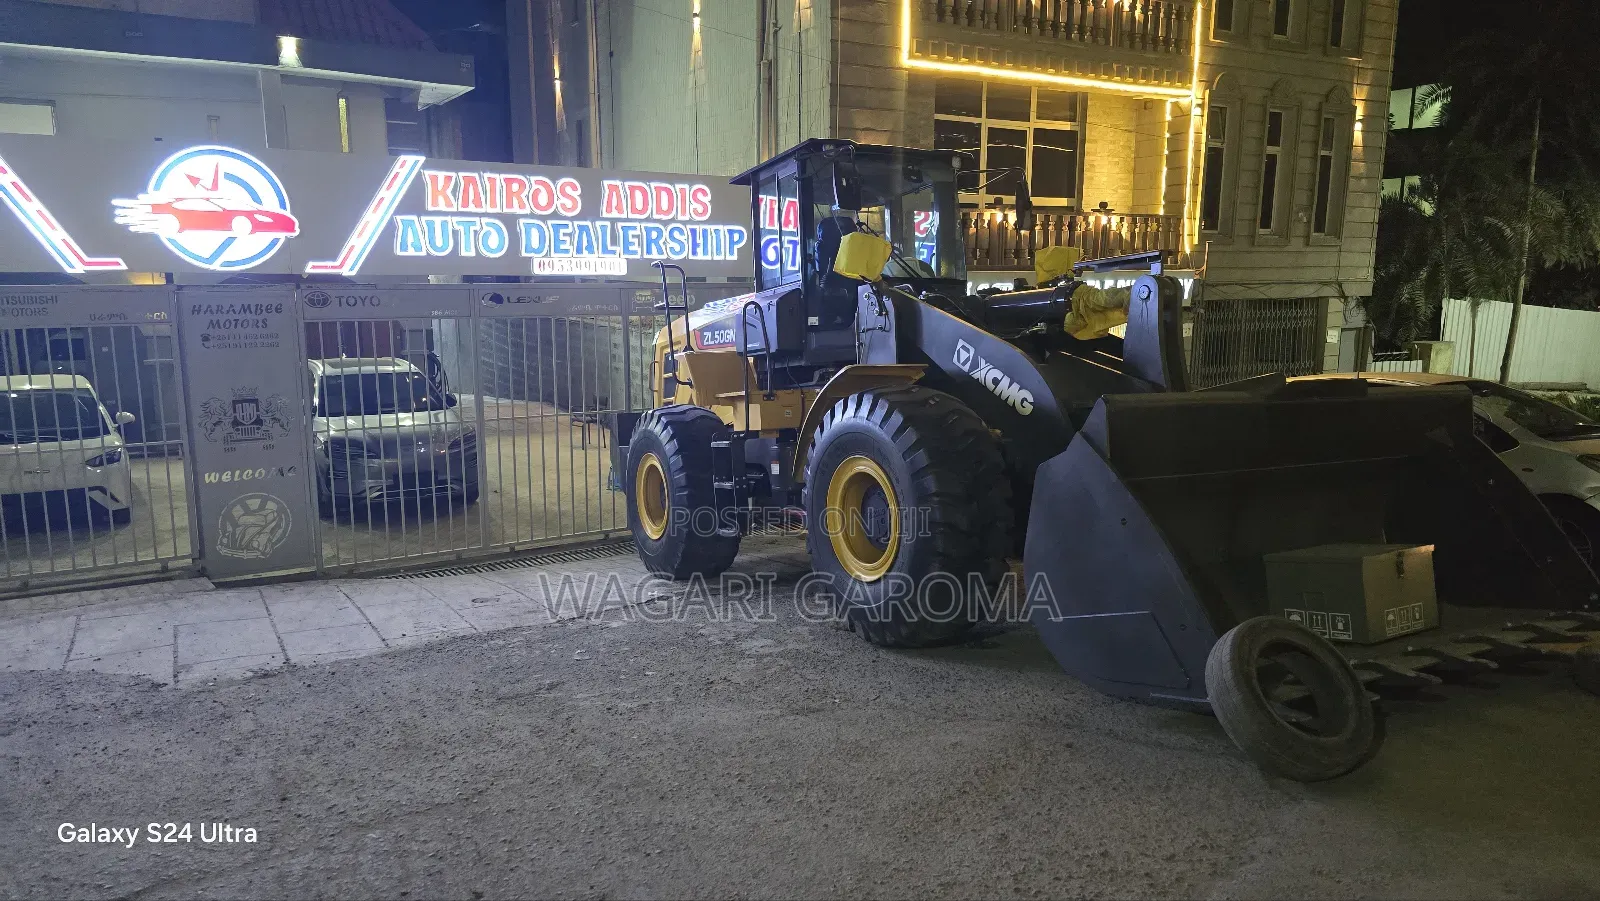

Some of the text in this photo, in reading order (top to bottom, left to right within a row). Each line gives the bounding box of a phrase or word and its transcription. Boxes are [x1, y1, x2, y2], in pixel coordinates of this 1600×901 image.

[424, 171, 581, 216] KAIROS
[602, 181, 711, 220] ADDIS
[395, 216, 747, 260] AUTO DEALERSHIP
[191, 303, 283, 315] HARAMBEE
[665, 293, 696, 309] eep
[207, 318, 268, 330] MOTORS
[703, 329, 737, 346] ZL50GN
[969, 355, 1034, 416] XCMG
